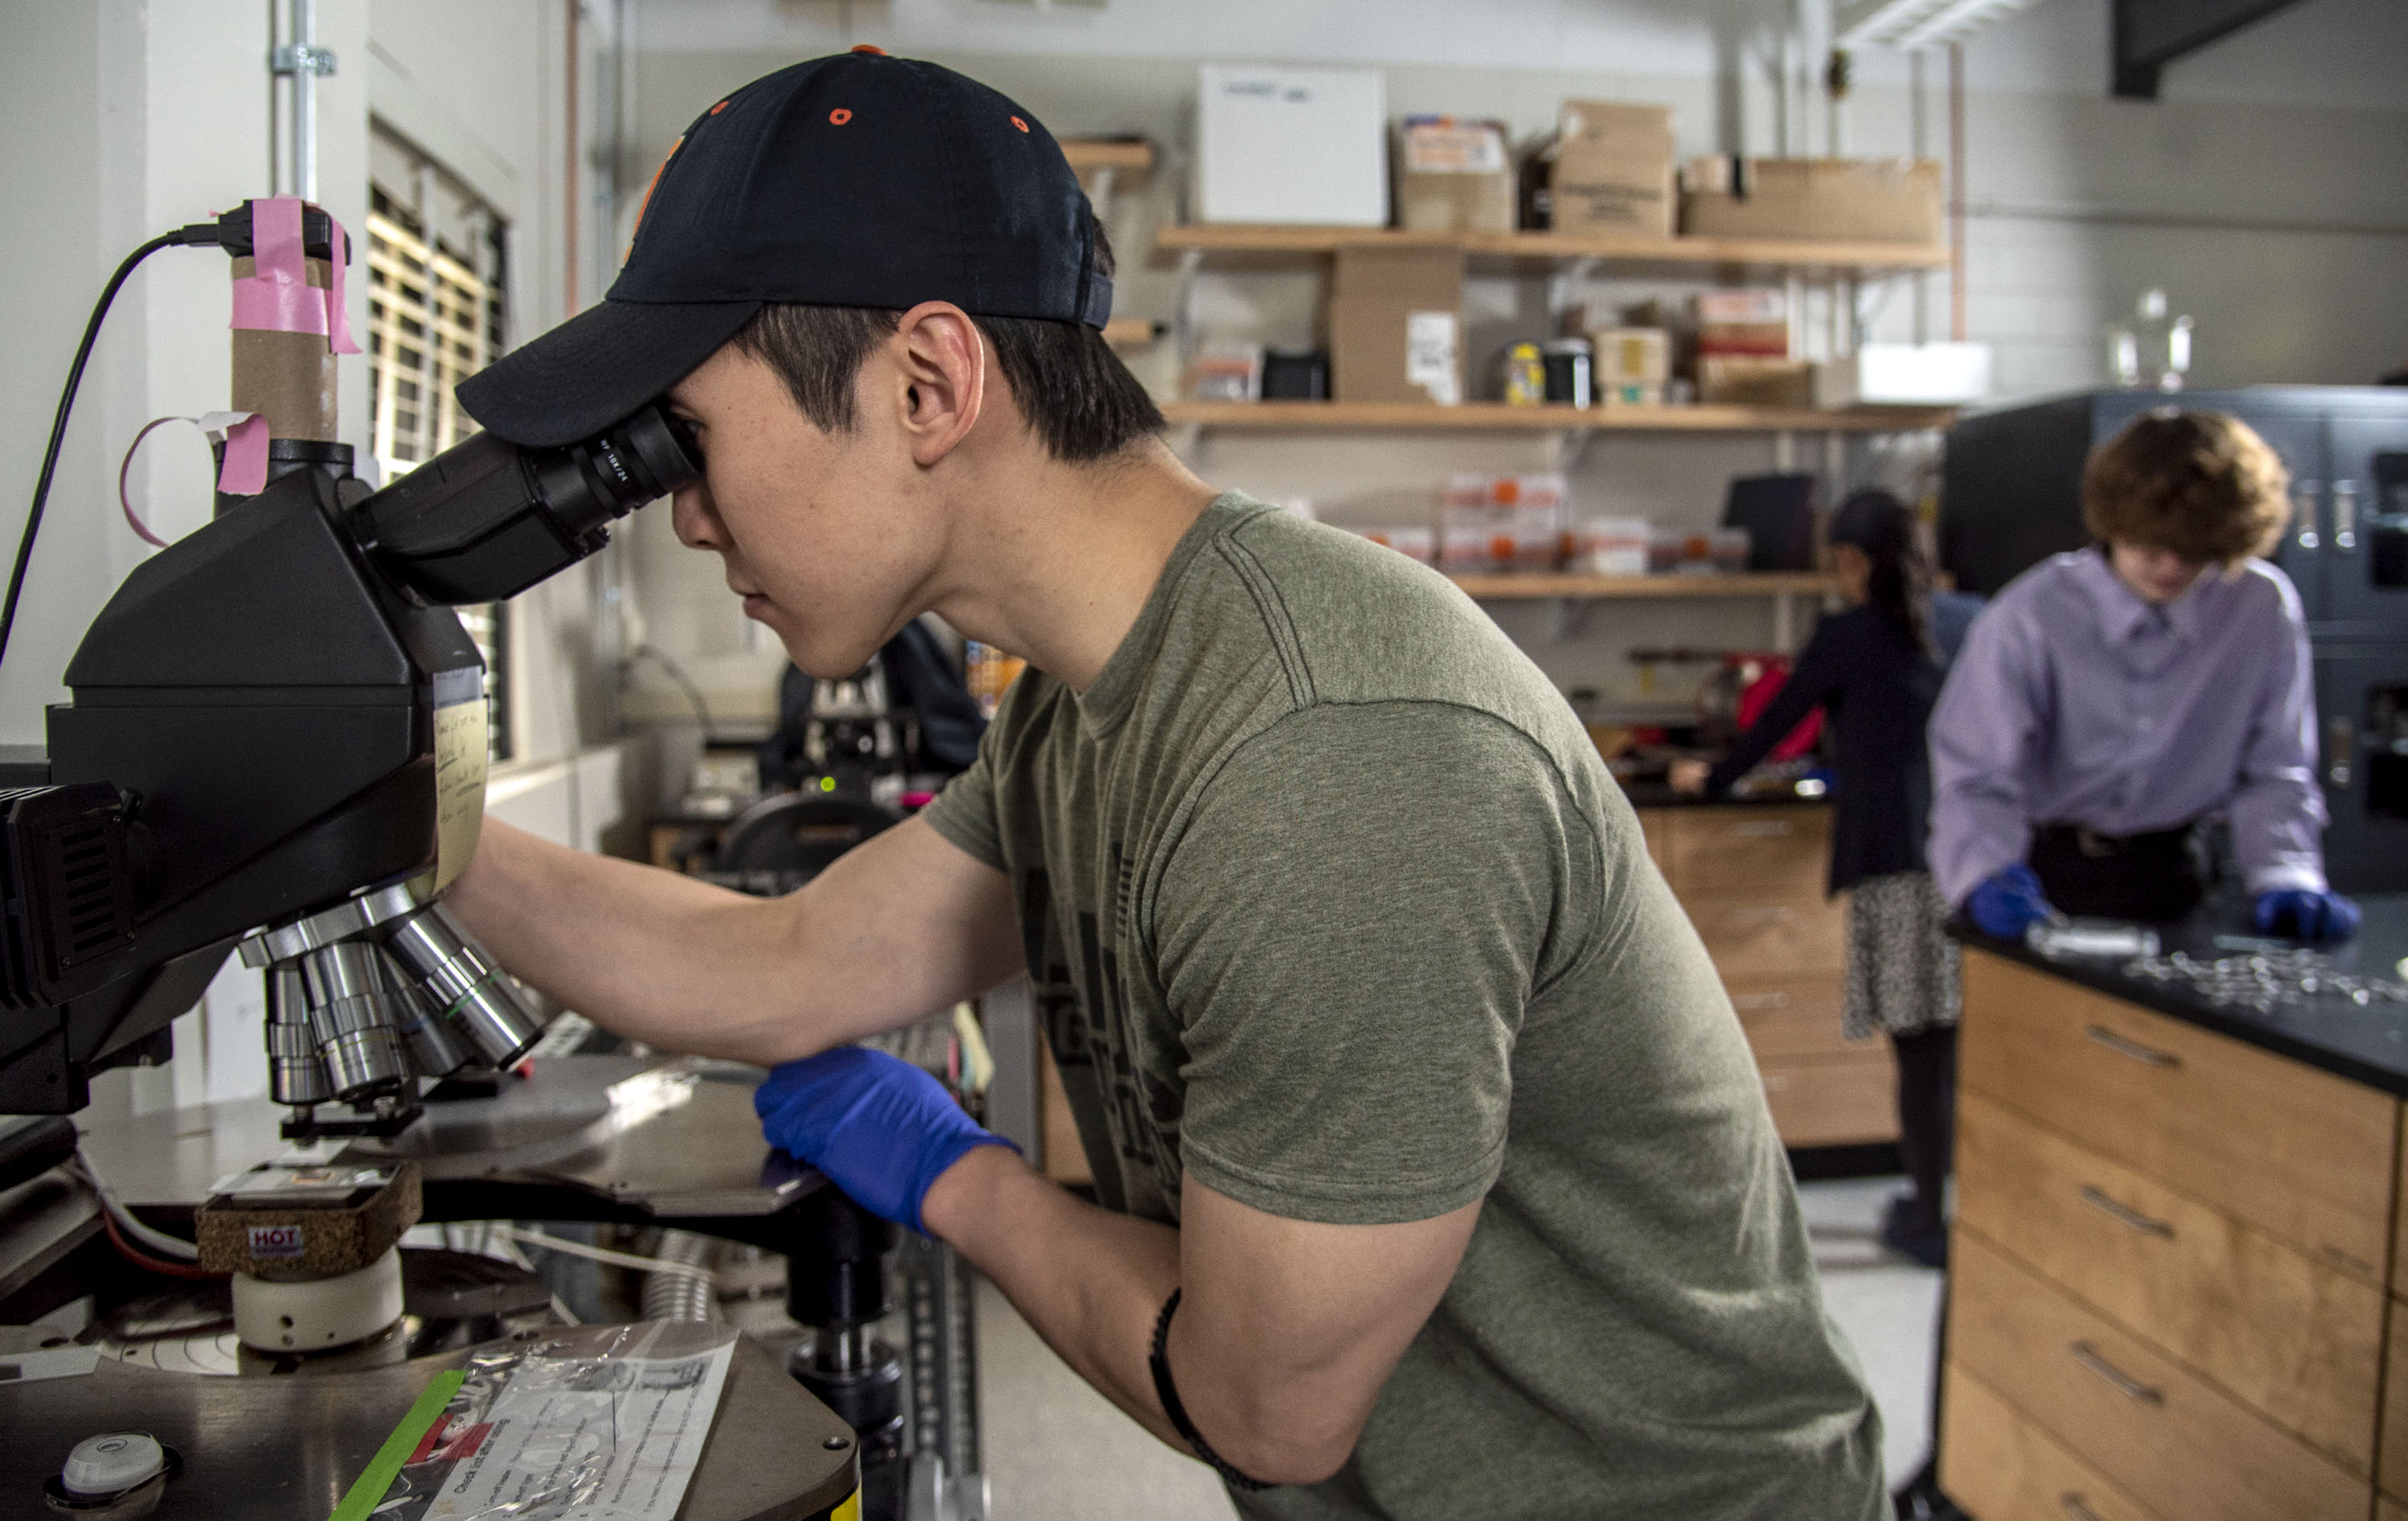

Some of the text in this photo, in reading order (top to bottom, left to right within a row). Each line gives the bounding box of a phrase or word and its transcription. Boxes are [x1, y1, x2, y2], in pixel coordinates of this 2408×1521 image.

[608, 453, 628, 482] 10X/24
[254, 1230, 295, 1246] HOT
[454, 1470, 478, 1493] Check
[469, 1457, 486, 1469] list
